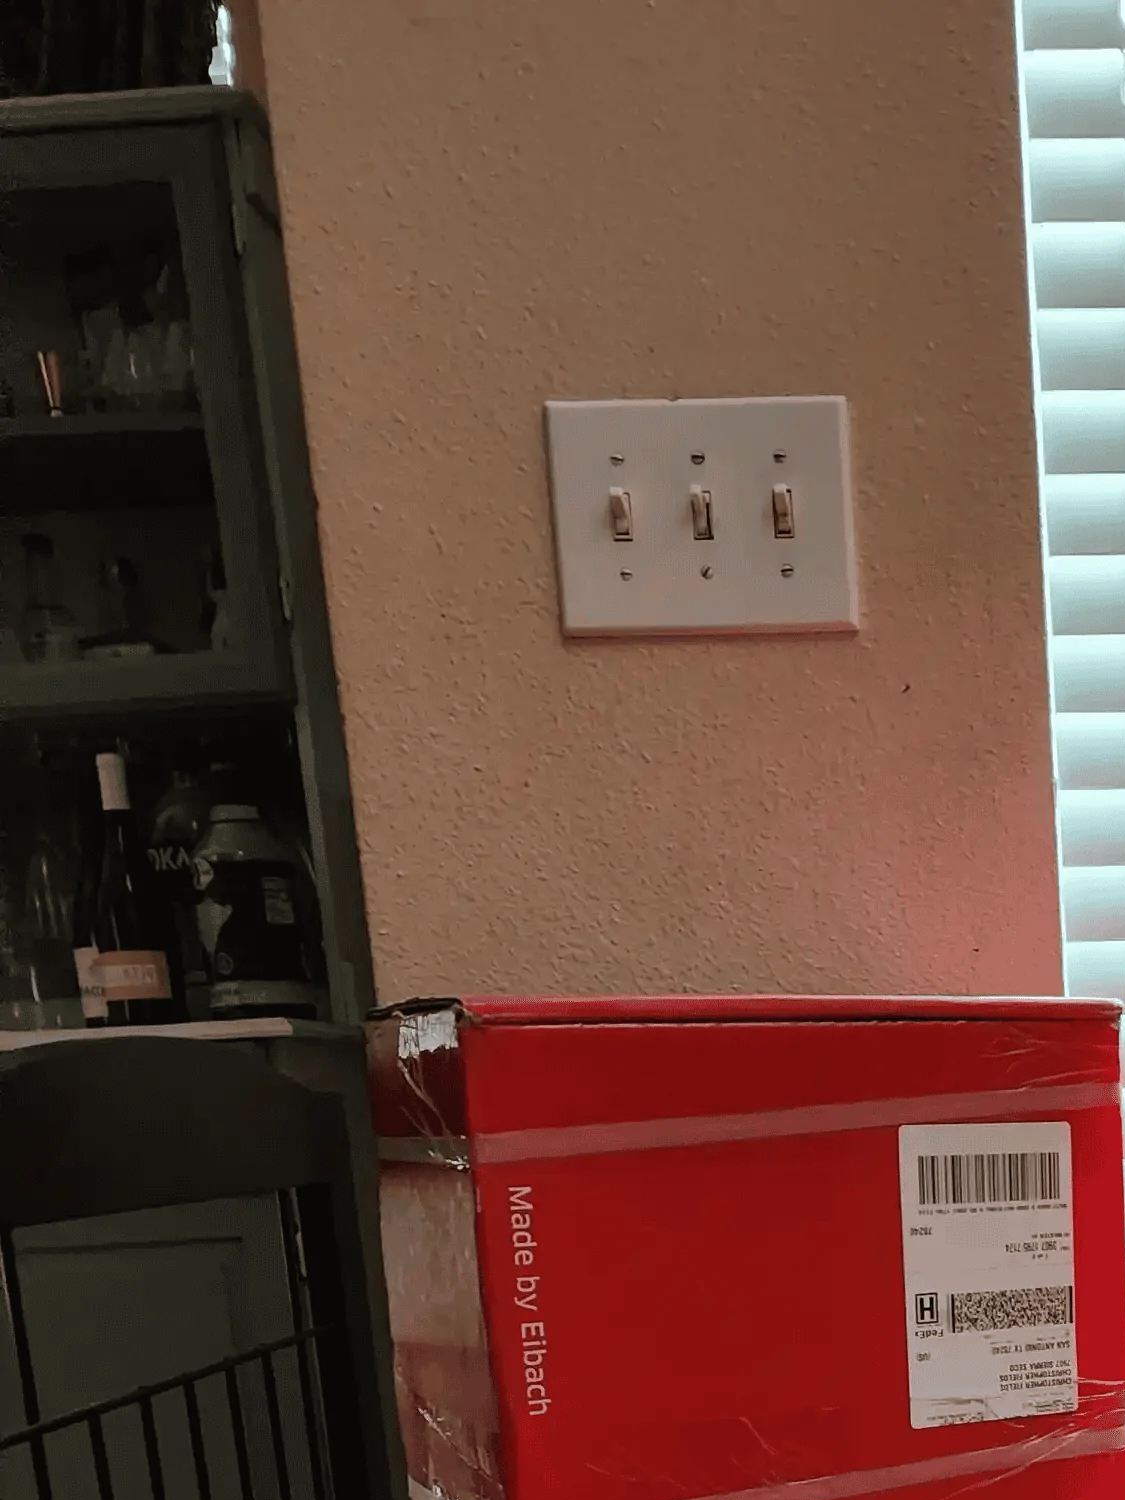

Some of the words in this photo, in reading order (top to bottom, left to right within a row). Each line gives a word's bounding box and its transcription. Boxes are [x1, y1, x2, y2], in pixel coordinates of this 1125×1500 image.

[507, 1185, 537, 1266] Made
[515, 1276, 540, 1311] by
[919, 1296, 935, 1321] H
[915, 1329, 944, 1339] FedEx
[521, 1321, 551, 1416] Eibach
[1029, 1361, 1055, 1370] SIERRA
[999, 1373, 1023, 1382] FIELDS
[1025, 1369, 1072, 1380] CHRISTOPHER
[1025, 1378, 1072, 1389] CHRISTOPHER
